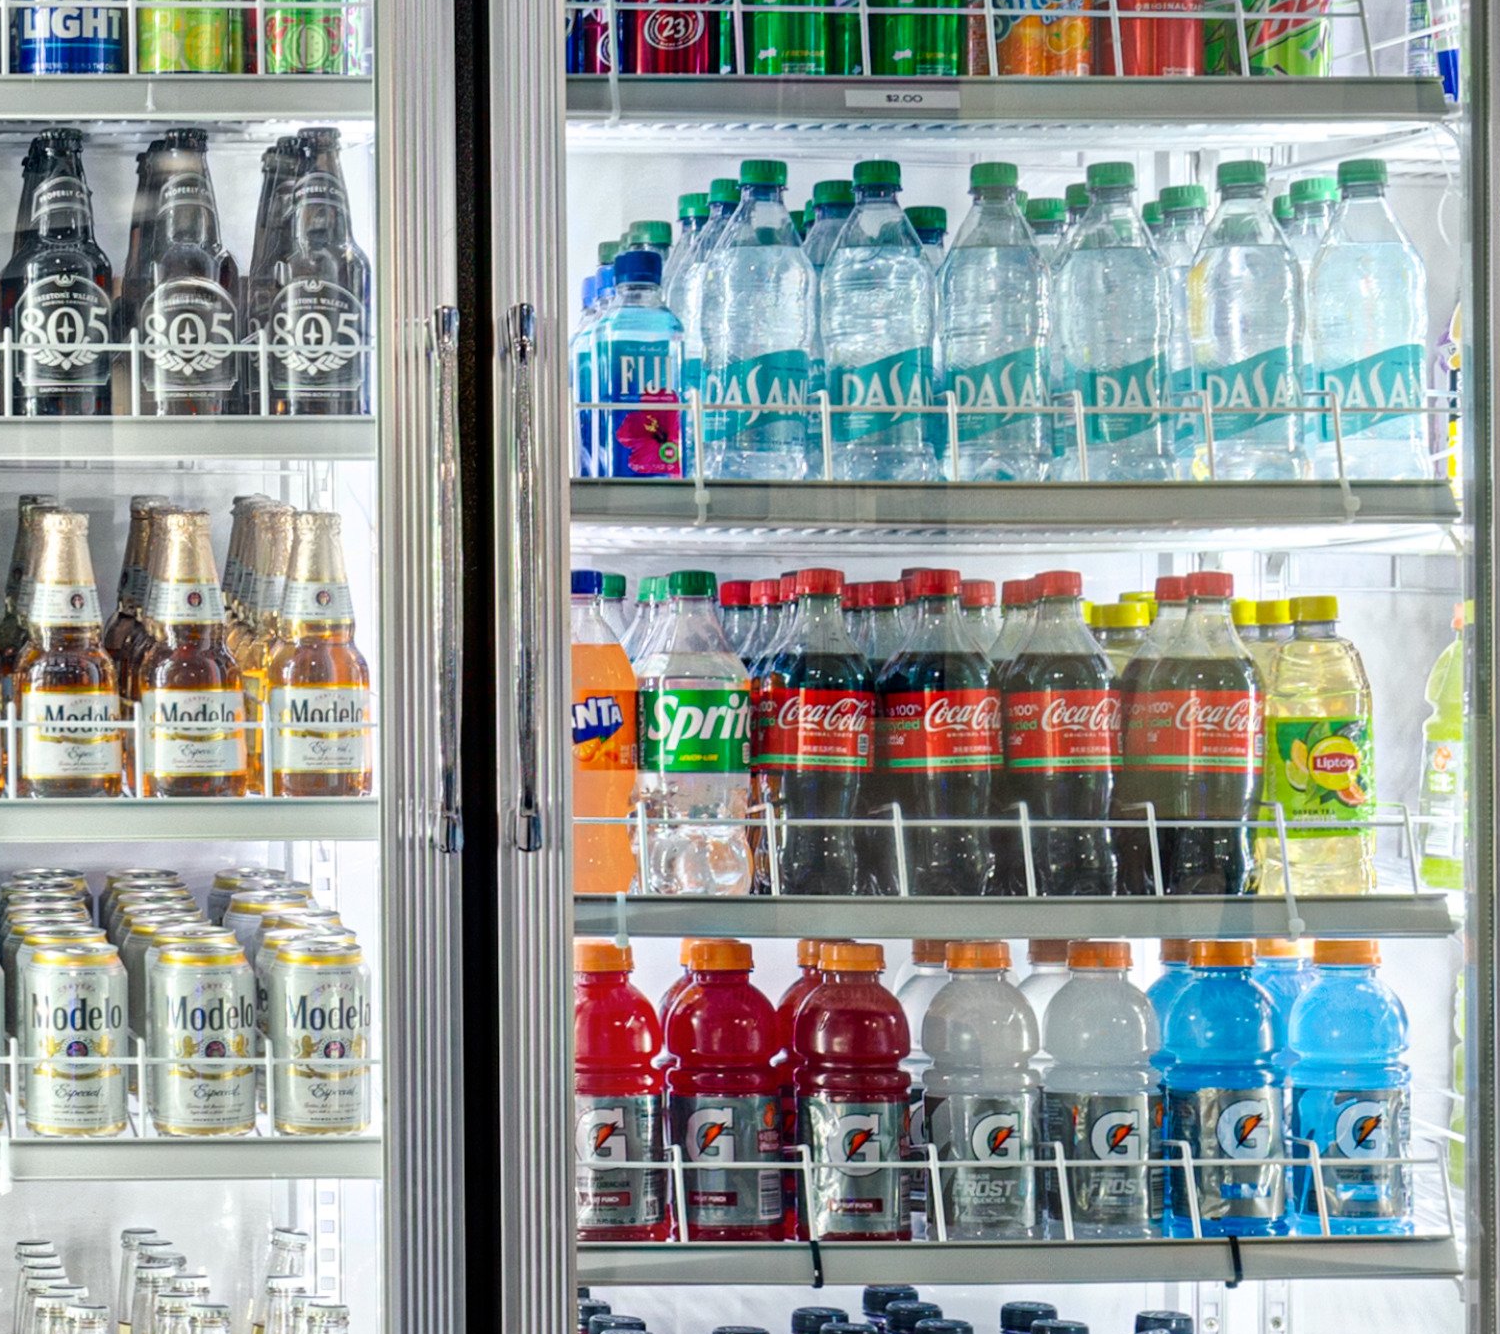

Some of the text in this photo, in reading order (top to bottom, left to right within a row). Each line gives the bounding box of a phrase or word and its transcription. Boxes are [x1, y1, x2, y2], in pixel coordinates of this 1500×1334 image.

[23, 6, 120, 39] LIGHT
[662, 20, 686, 37] 23
[886, 94, 923, 103] $2.00
[21, 308, 109, 355] 805
[620, 355, 674, 395] FIJI
[777, 695, 869, 733] Coca-Cola
[1317, 757, 1356, 771] Lipton
[167, 994, 254, 1029] Modelo
[828, 1113, 883, 1177] G
